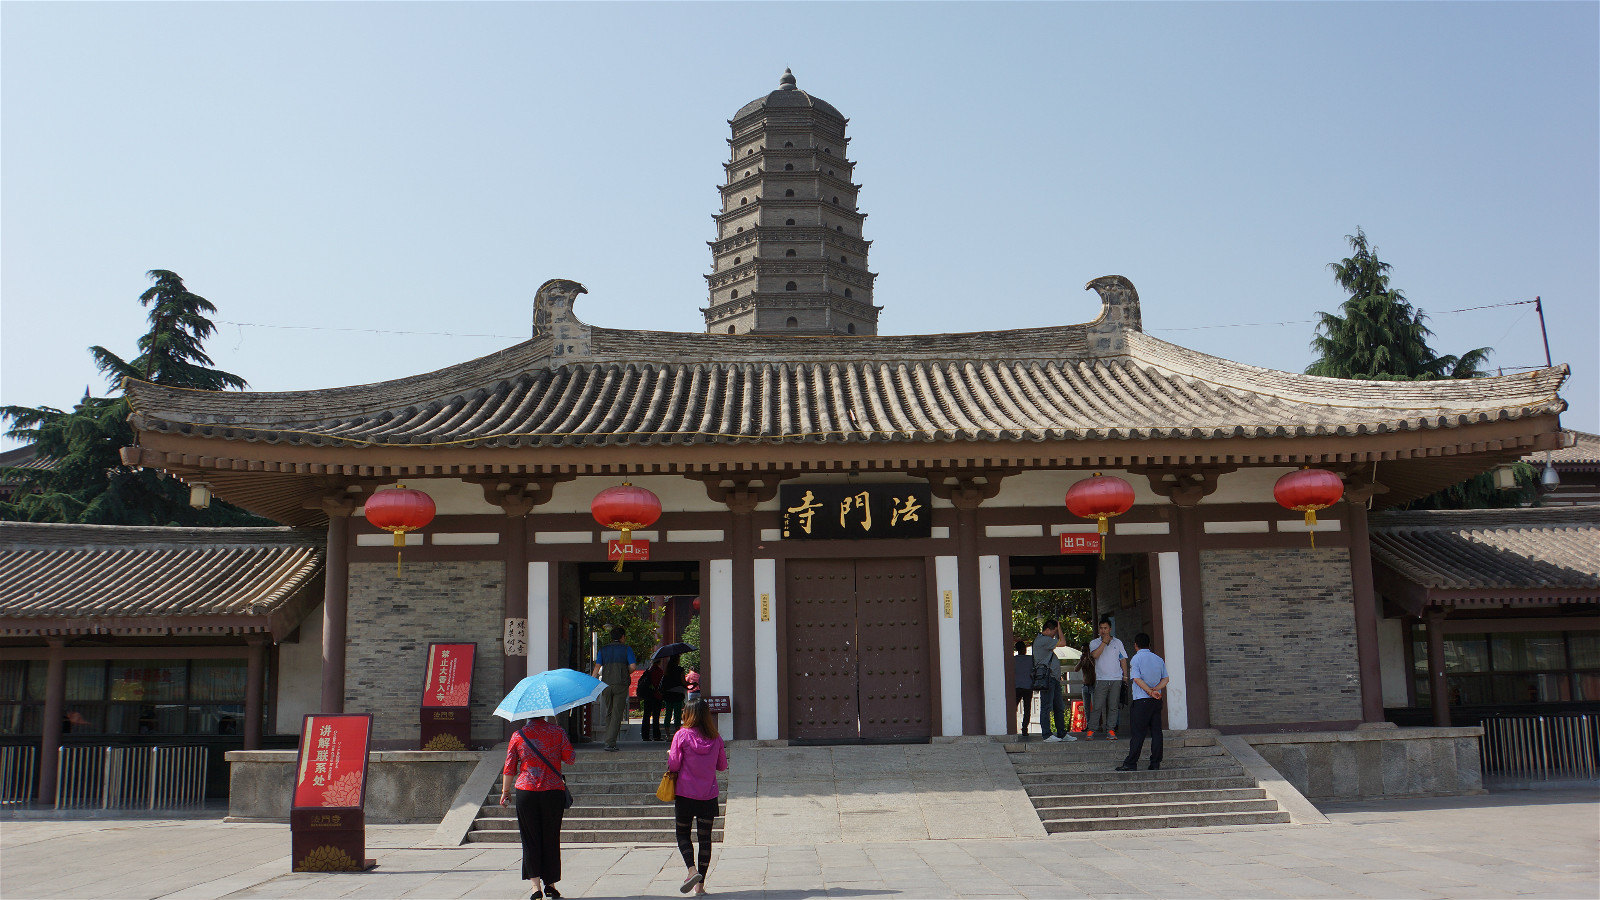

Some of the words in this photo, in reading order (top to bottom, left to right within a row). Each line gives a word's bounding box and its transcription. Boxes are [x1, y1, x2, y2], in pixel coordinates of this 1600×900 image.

[611, 543, 634, 554] 入口
[1064, 536, 1085, 547] 出口
[436, 649, 451, 702] 禁止大香入寺
[312, 724, 332, 787] 讲解联系处
